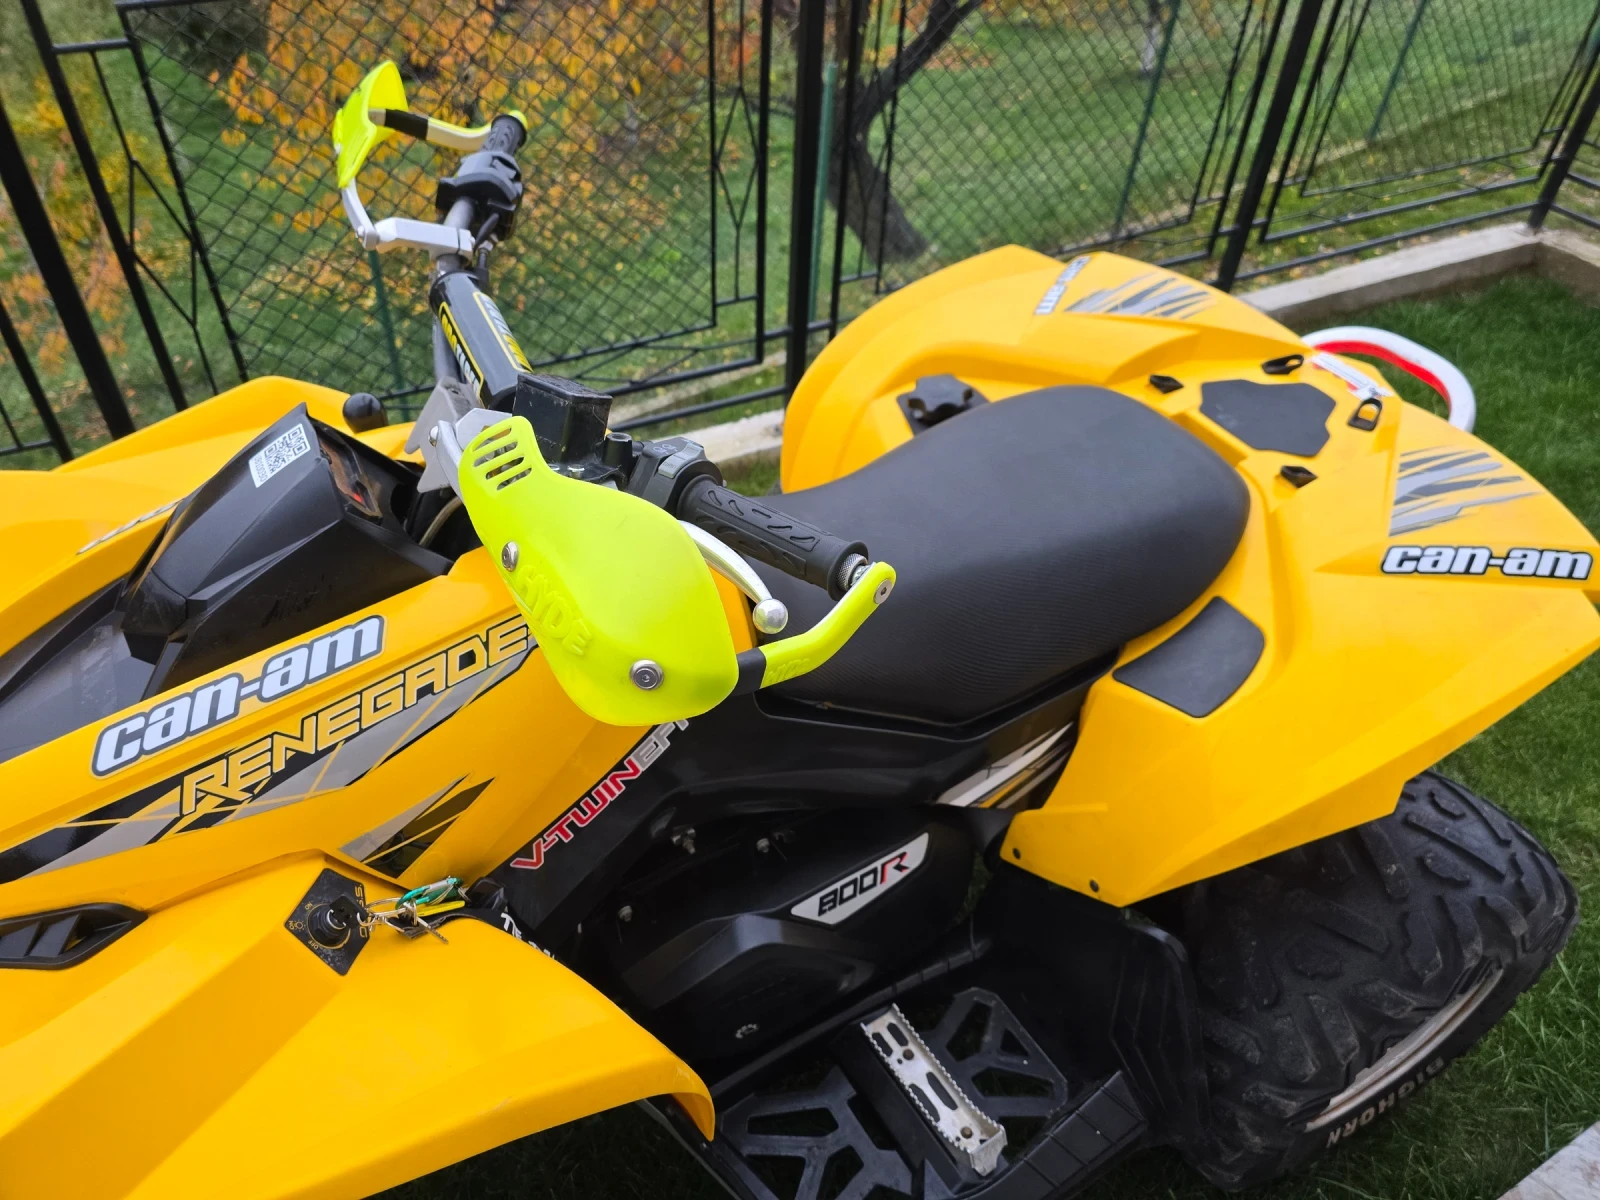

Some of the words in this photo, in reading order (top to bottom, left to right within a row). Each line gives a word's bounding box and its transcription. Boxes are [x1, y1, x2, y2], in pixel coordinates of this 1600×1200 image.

[1381, 546, 1593, 580] can-am
[93, 616, 384, 775] can-am
[180, 614, 528, 816] RENEGADE
[818, 851, 910, 917] 800R
[1326, 1058, 1444, 1149] BIGHORN
